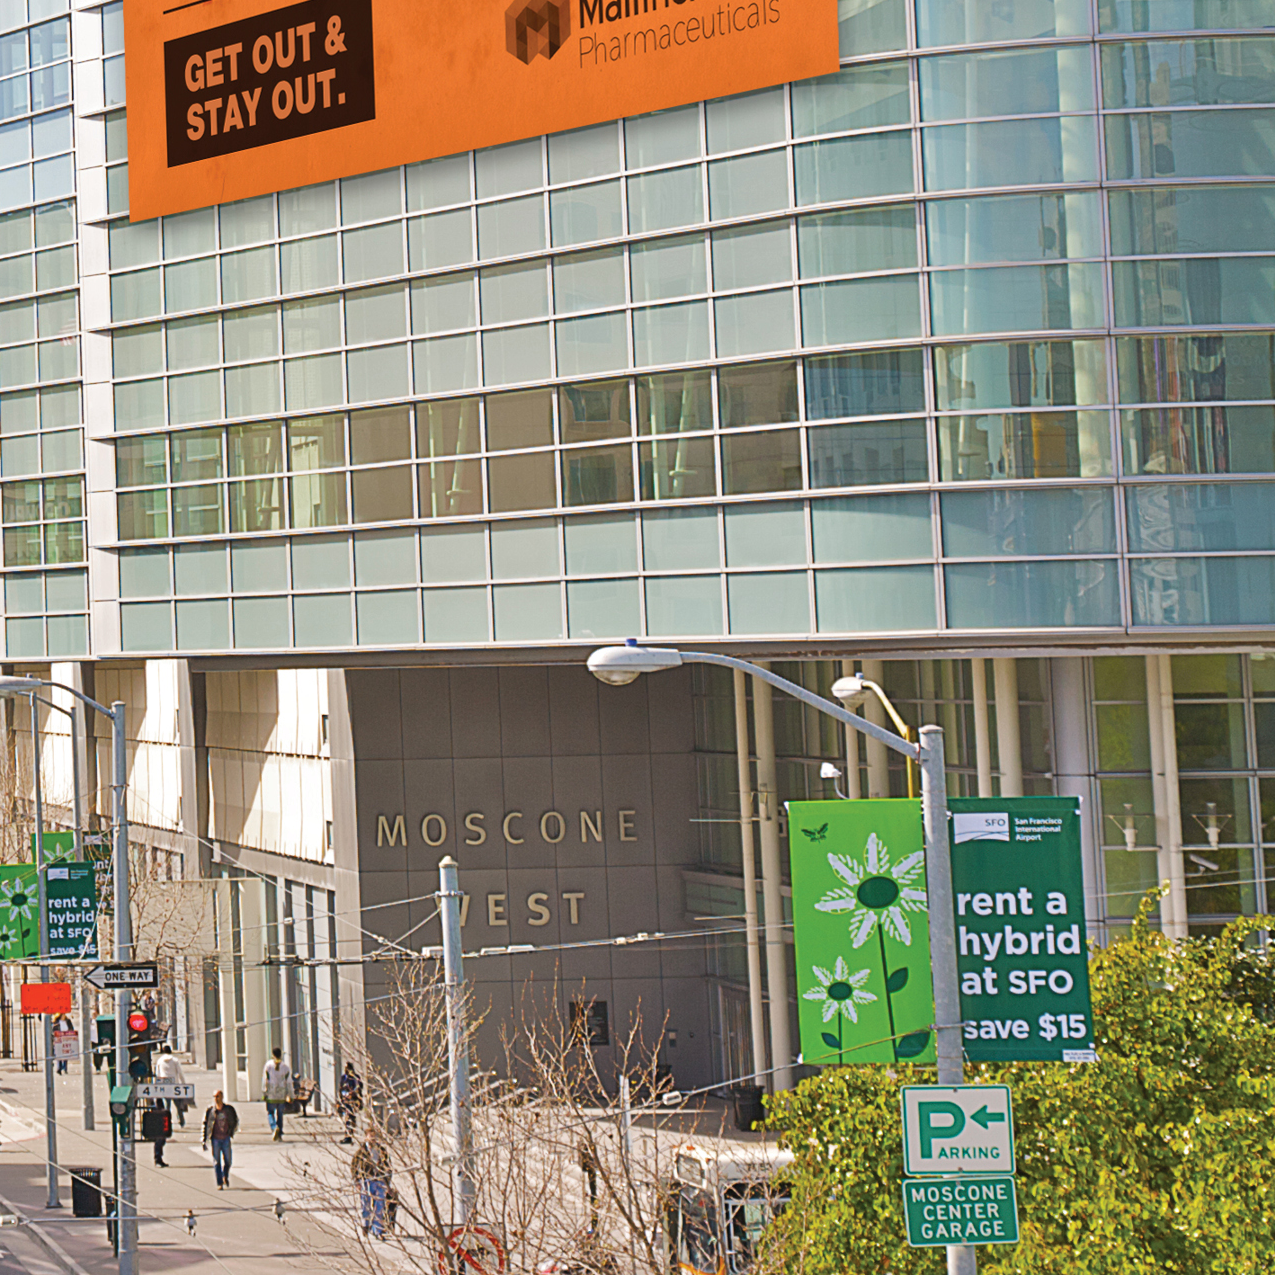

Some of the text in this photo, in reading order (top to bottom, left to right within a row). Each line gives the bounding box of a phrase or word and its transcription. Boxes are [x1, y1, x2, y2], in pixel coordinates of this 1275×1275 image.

[184, 14, 347, 92] GET OUT &
[186, 68, 346, 141] STAY OUT.
[376, 810, 638, 847] MOSCONE
[985, 818, 1006, 827] SFO
[1014, 816, 1063, 825] San Francisco
[1015, 834, 1042, 842] Airport
[48, 896, 77, 909] rent
[81, 898, 90, 908] a
[957, 888, 1067, 916] rent a
[48, 910, 95, 926] hybrid
[50, 927, 92, 938] at SFO
[50, 946, 75, 956] save
[958, 924, 1081, 961] hybrid
[105, 971, 149, 981] ONE WAY
[961, 967, 1073, 995] at SFO
[964, 1012, 1087, 1041] save $15
[142, 1086, 190, 1096] 4TH ST
[911, 1184, 1008, 1203] MOSCONE
[923, 1203, 1000, 1221] CENTER
[921, 1221, 1005, 1239] GARAGE
